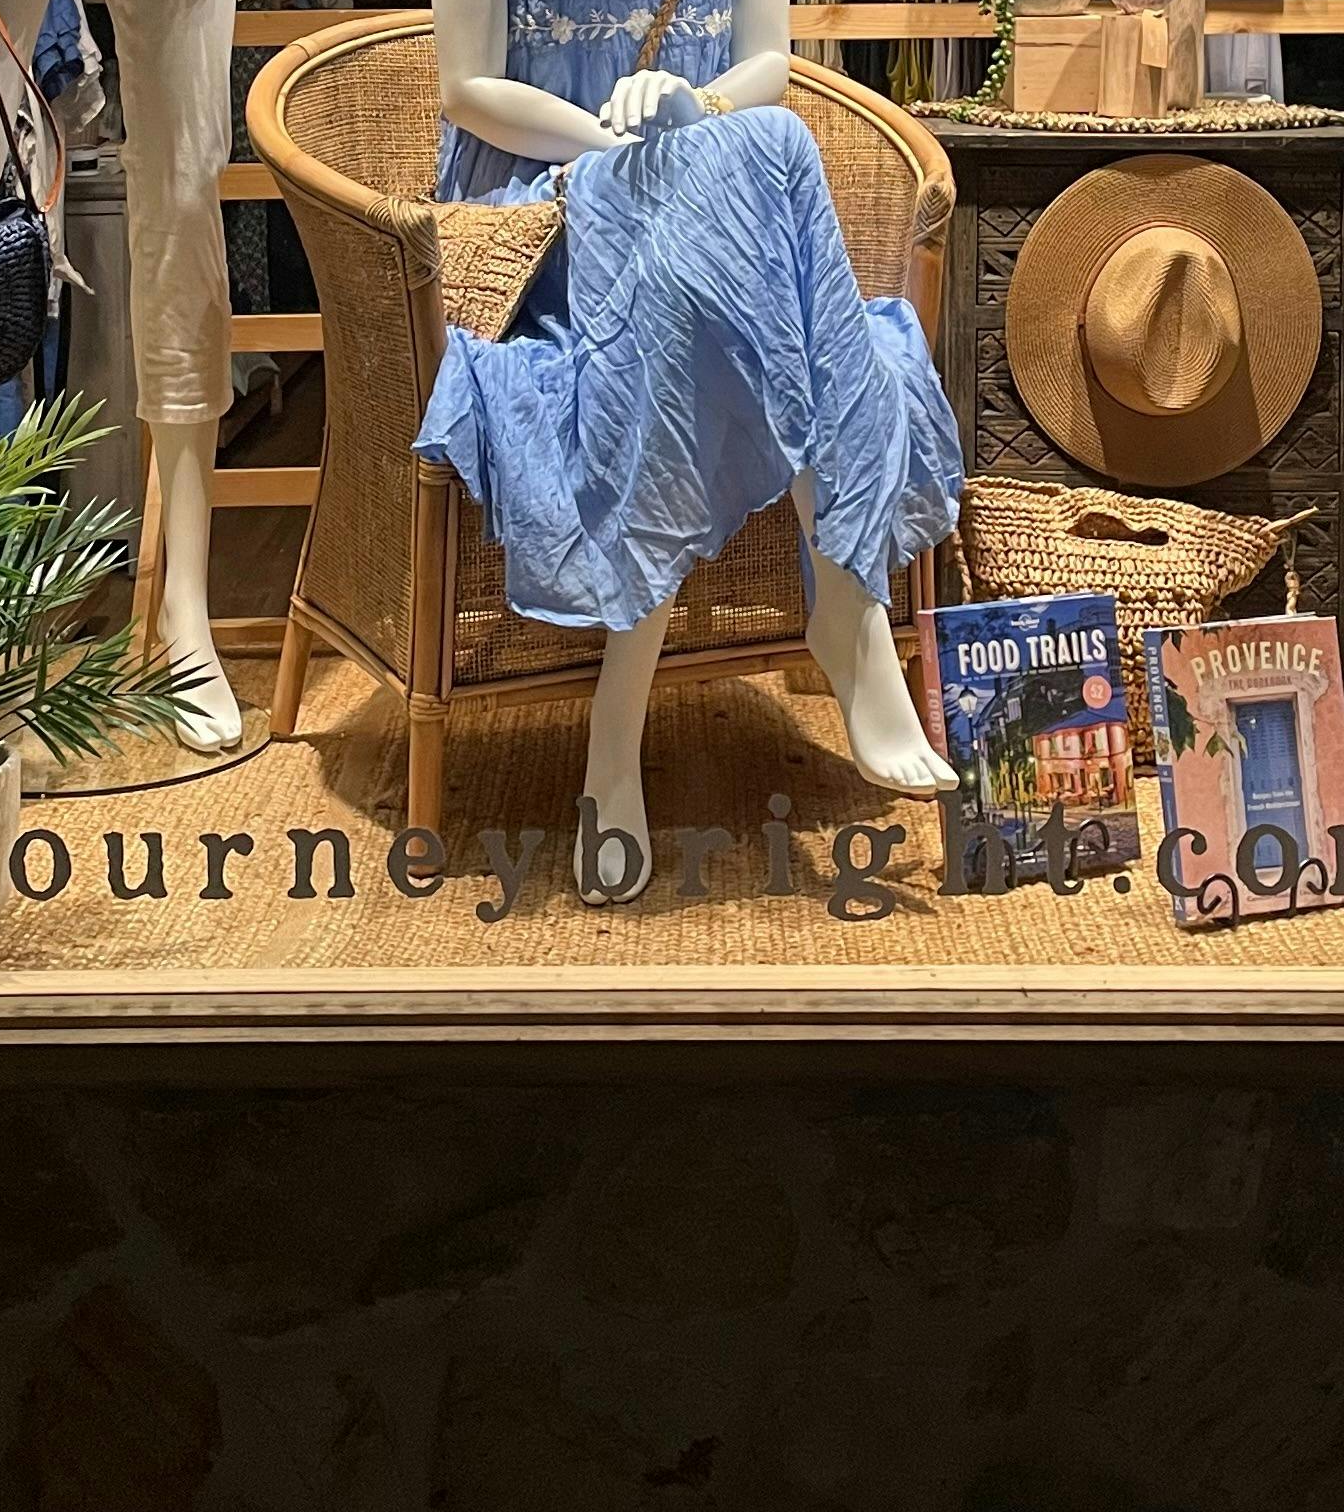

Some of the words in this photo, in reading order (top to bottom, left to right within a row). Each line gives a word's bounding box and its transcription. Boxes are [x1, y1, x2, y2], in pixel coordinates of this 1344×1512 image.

[958, 638, 1021, 676] FOOD
[1026, 629, 1108, 668] TRAILS
[1190, 641, 1323, 687] PROVENCE
[1147, 646, 1164, 723] PROVENCE
